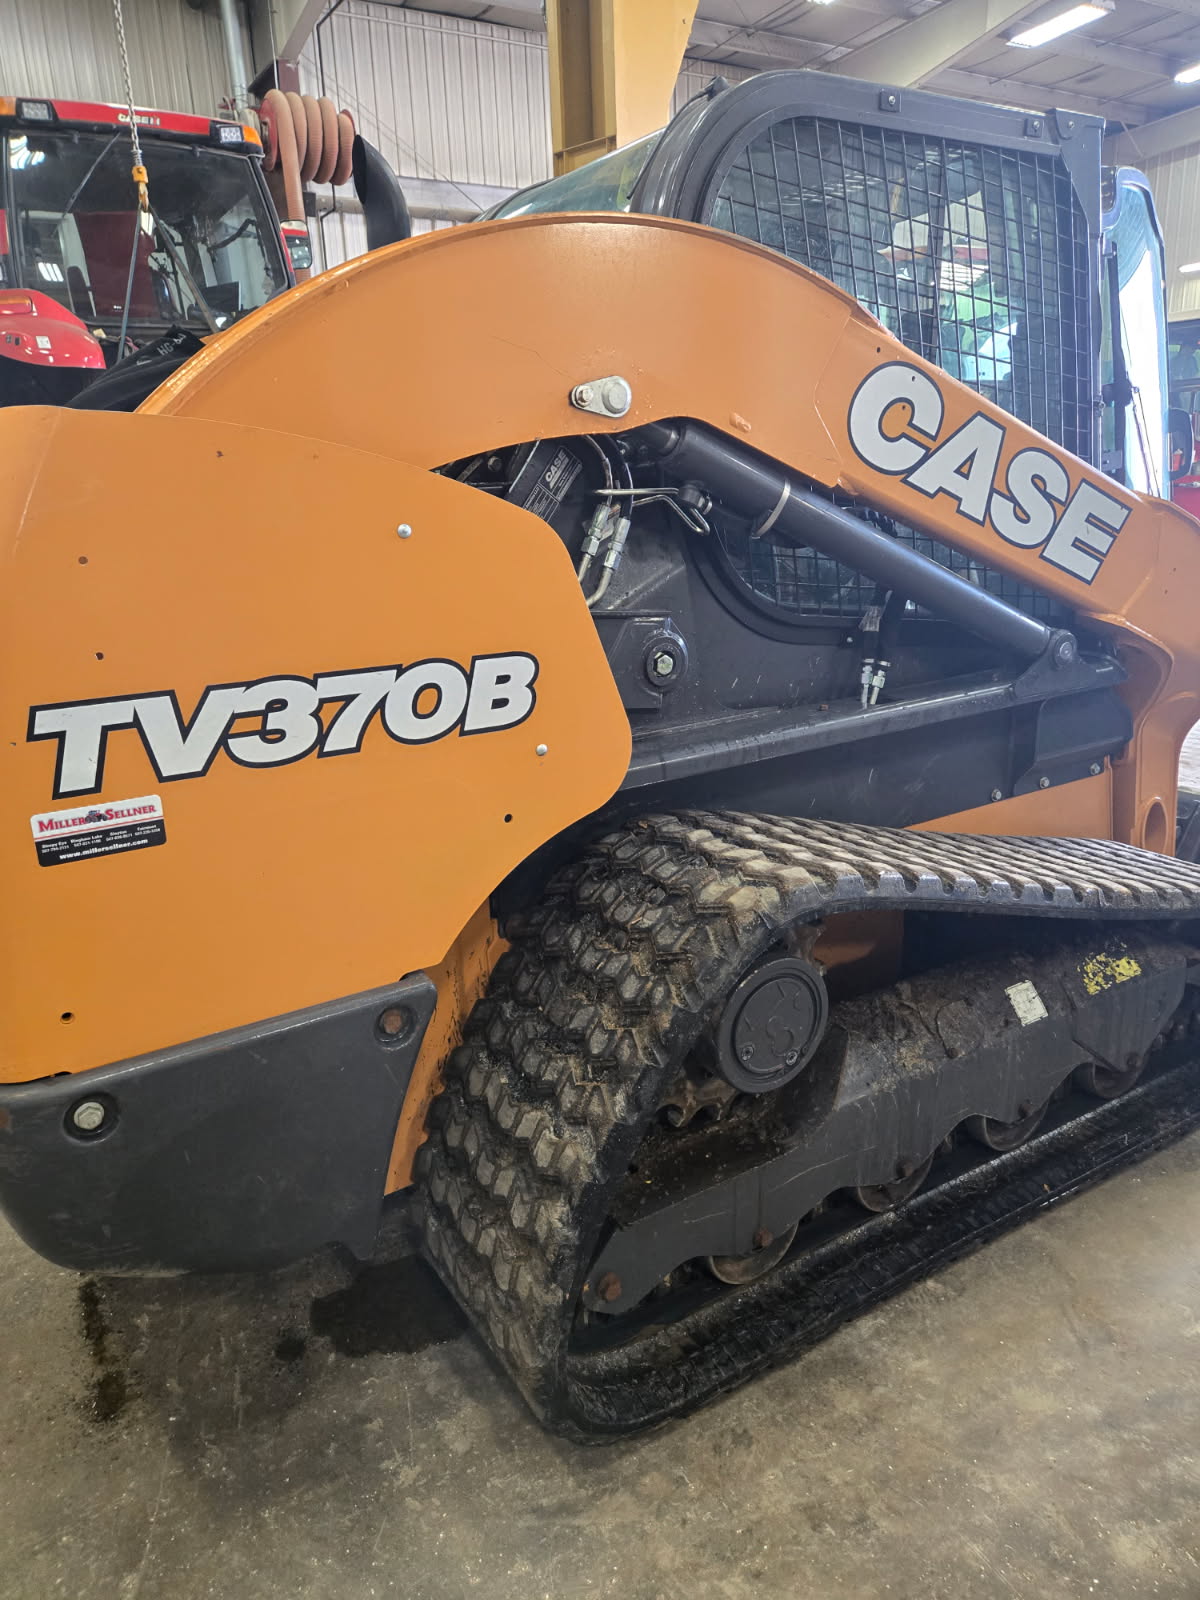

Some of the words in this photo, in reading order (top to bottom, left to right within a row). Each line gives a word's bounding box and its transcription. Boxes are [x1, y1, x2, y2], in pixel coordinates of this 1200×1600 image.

[545, 449, 567, 482] CASE
[847, 360, 1133, 586] CASE
[26, 651, 539, 800] TV370B
